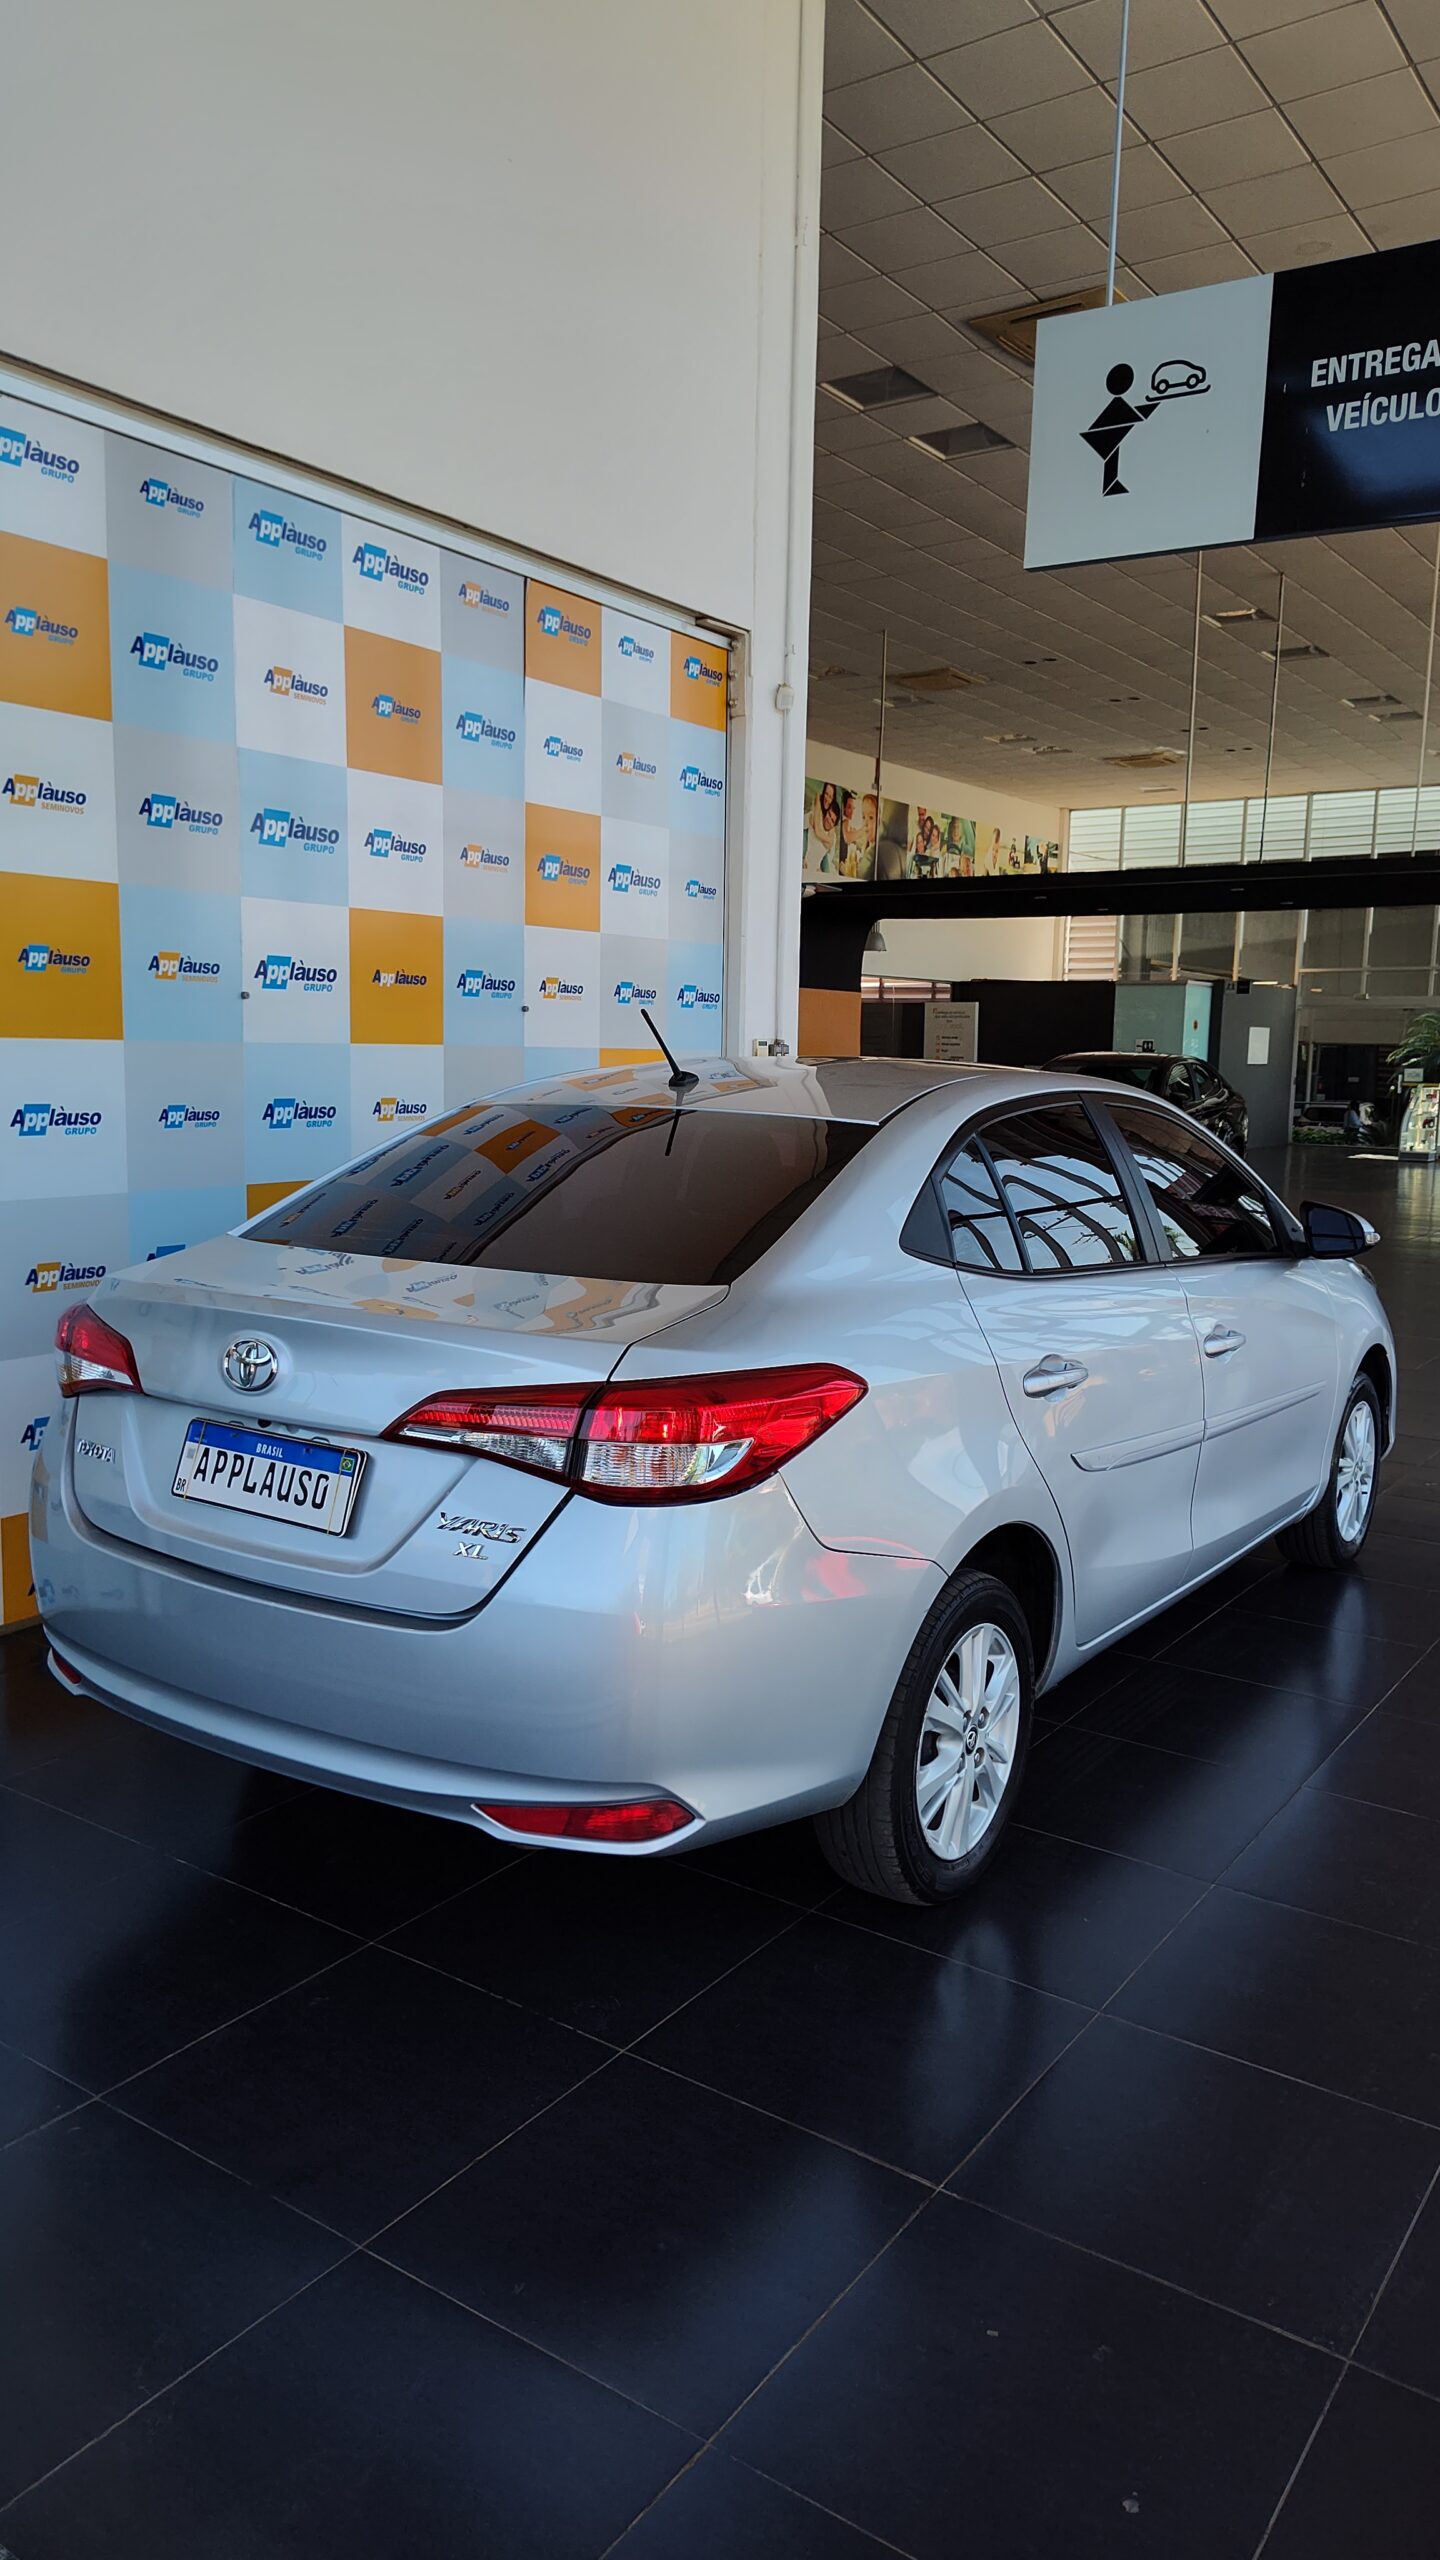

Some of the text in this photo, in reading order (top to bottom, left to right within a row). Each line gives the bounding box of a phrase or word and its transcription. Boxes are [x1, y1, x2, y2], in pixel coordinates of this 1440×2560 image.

[1310, 338, 1440, 388] ENTREGA
[1326, 387, 1440, 432] VEÍCULO
[0, 436, 80, 474] pplàuso
[41, 466, 75, 484] GRUPO
[295, 547, 323, 561] GRUPO
[398, 580, 425, 595] GRUPO
[183, 668, 214, 682] GRUPO
[41, 801, 85, 815] SEMINOVOS
[188, 823, 219, 835] GRUPO
[303, 842, 335, 854] GRUPO
[401, 853, 424, 863] GRUPO
[303, 983, 333, 993] GRUPO
[306, 1119, 333, 1128] GRUPO
[64, 1126, 98, 1136] GRUPO
[63, 1280, 102, 1290] SEMINOVO
[256, 1442, 283, 1459] BRASIL
[175, 1477, 187, 1492] BR
[193, 1447, 330, 1510] APPLAUSO
[436, 1511, 528, 1544] YARIS
[453, 1541, 489, 1560] XL
